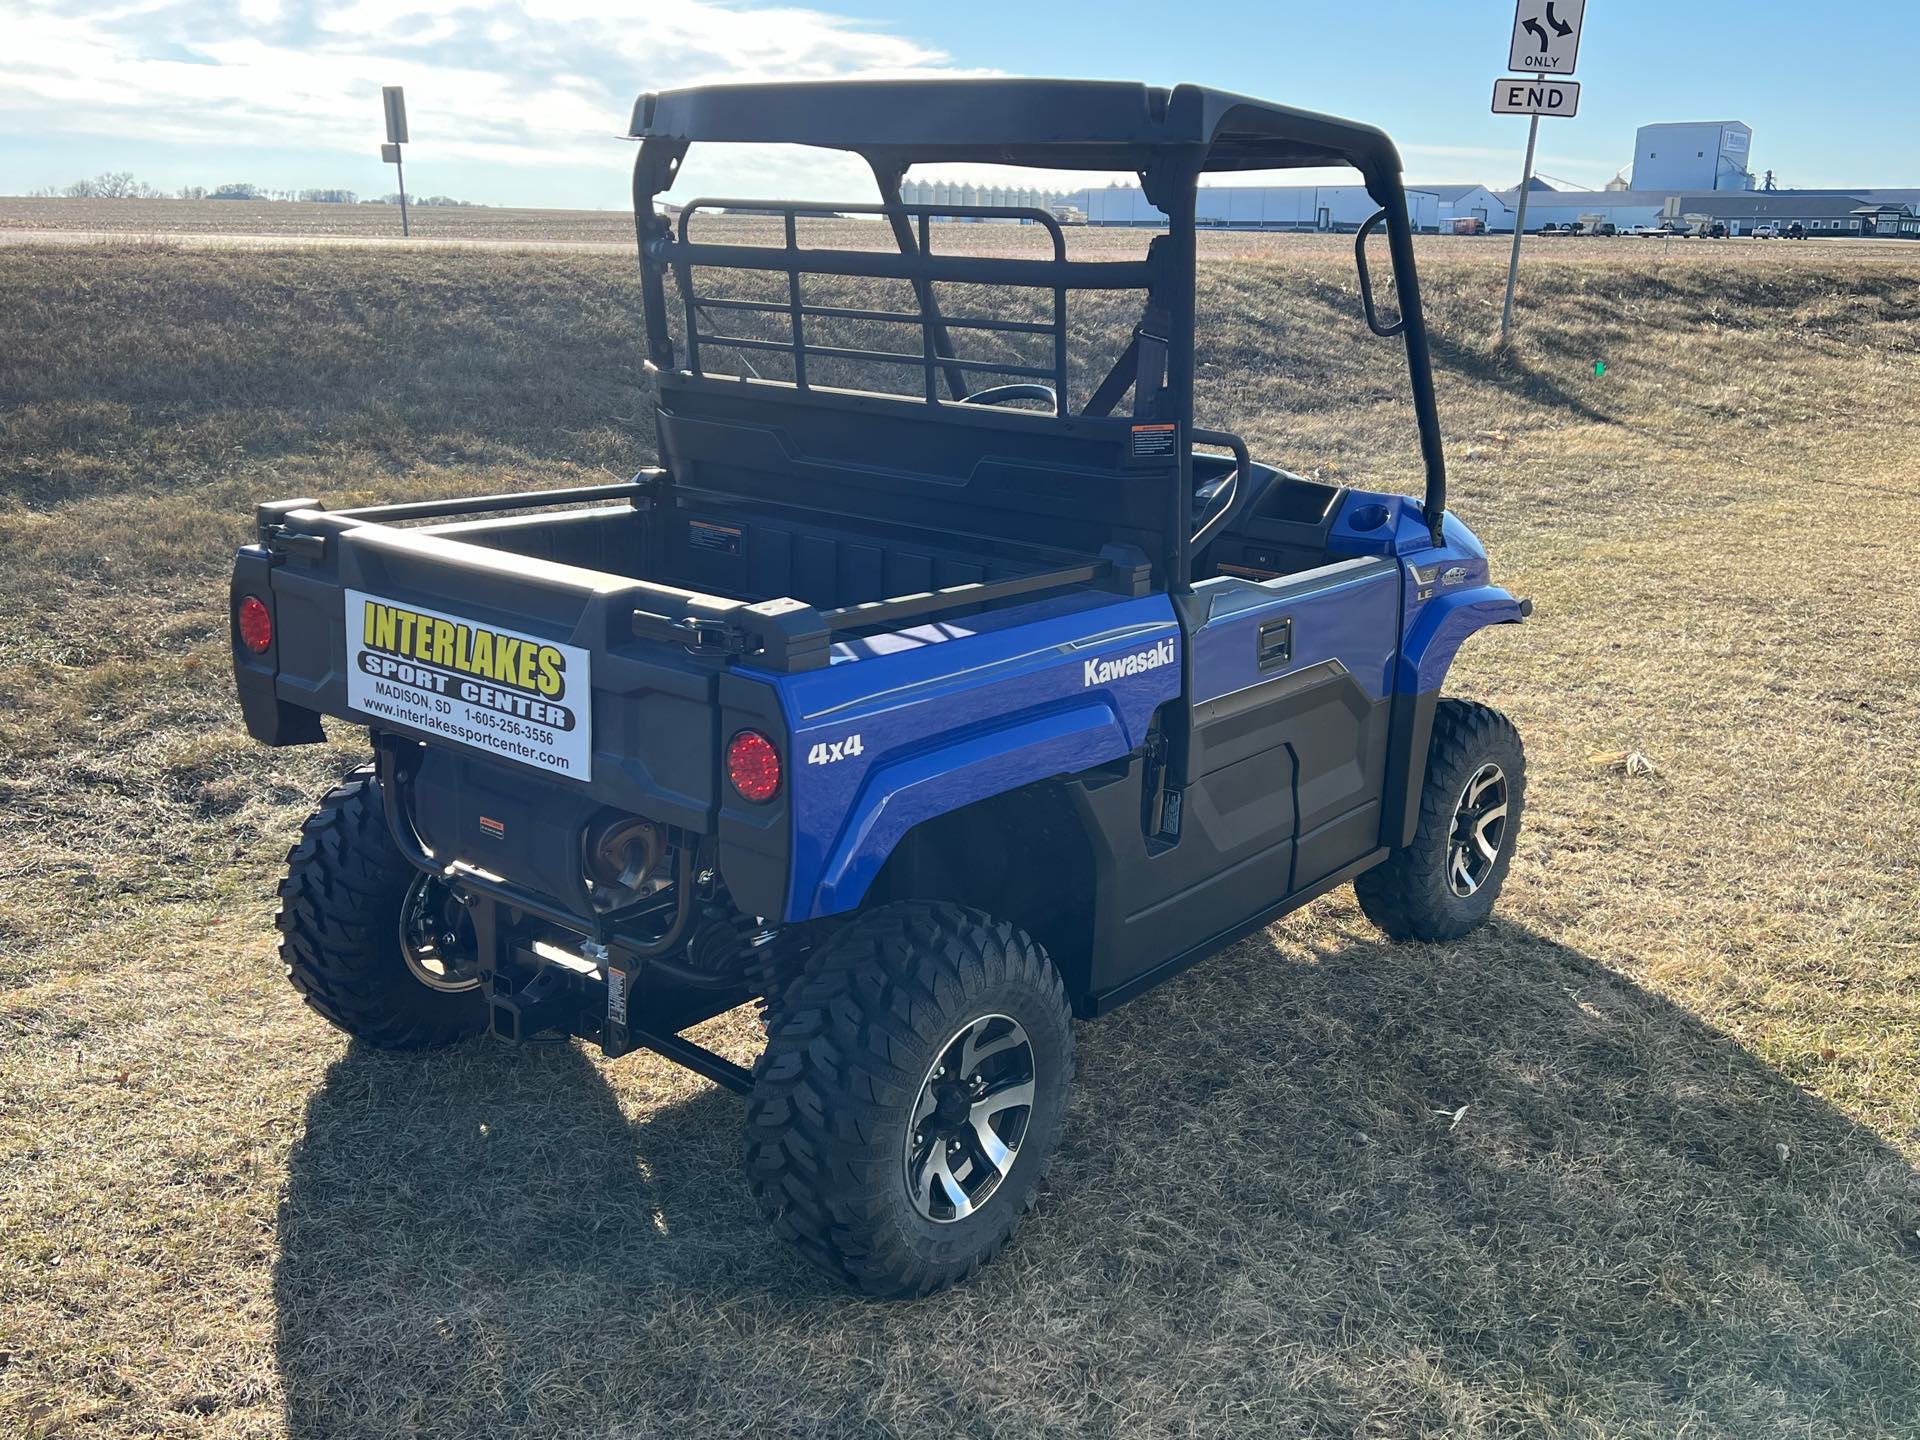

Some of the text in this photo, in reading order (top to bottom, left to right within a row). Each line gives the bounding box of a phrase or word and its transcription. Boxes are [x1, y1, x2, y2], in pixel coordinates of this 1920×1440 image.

[1525, 56, 1560, 68] ONLY
[1508, 87, 1563, 108] END
[1417, 589, 1432, 600] LE
[363, 601, 565, 699] INTERLAKES
[1084, 638, 1174, 687] Kawasaki
[365, 655, 566, 728] SPORT CENTER
[375, 681, 554, 746] MADISON, SD 1-605-256-3556
[363, 697, 570, 770] www.interlakessportcenter.com
[808, 734, 864, 765] 4x4
